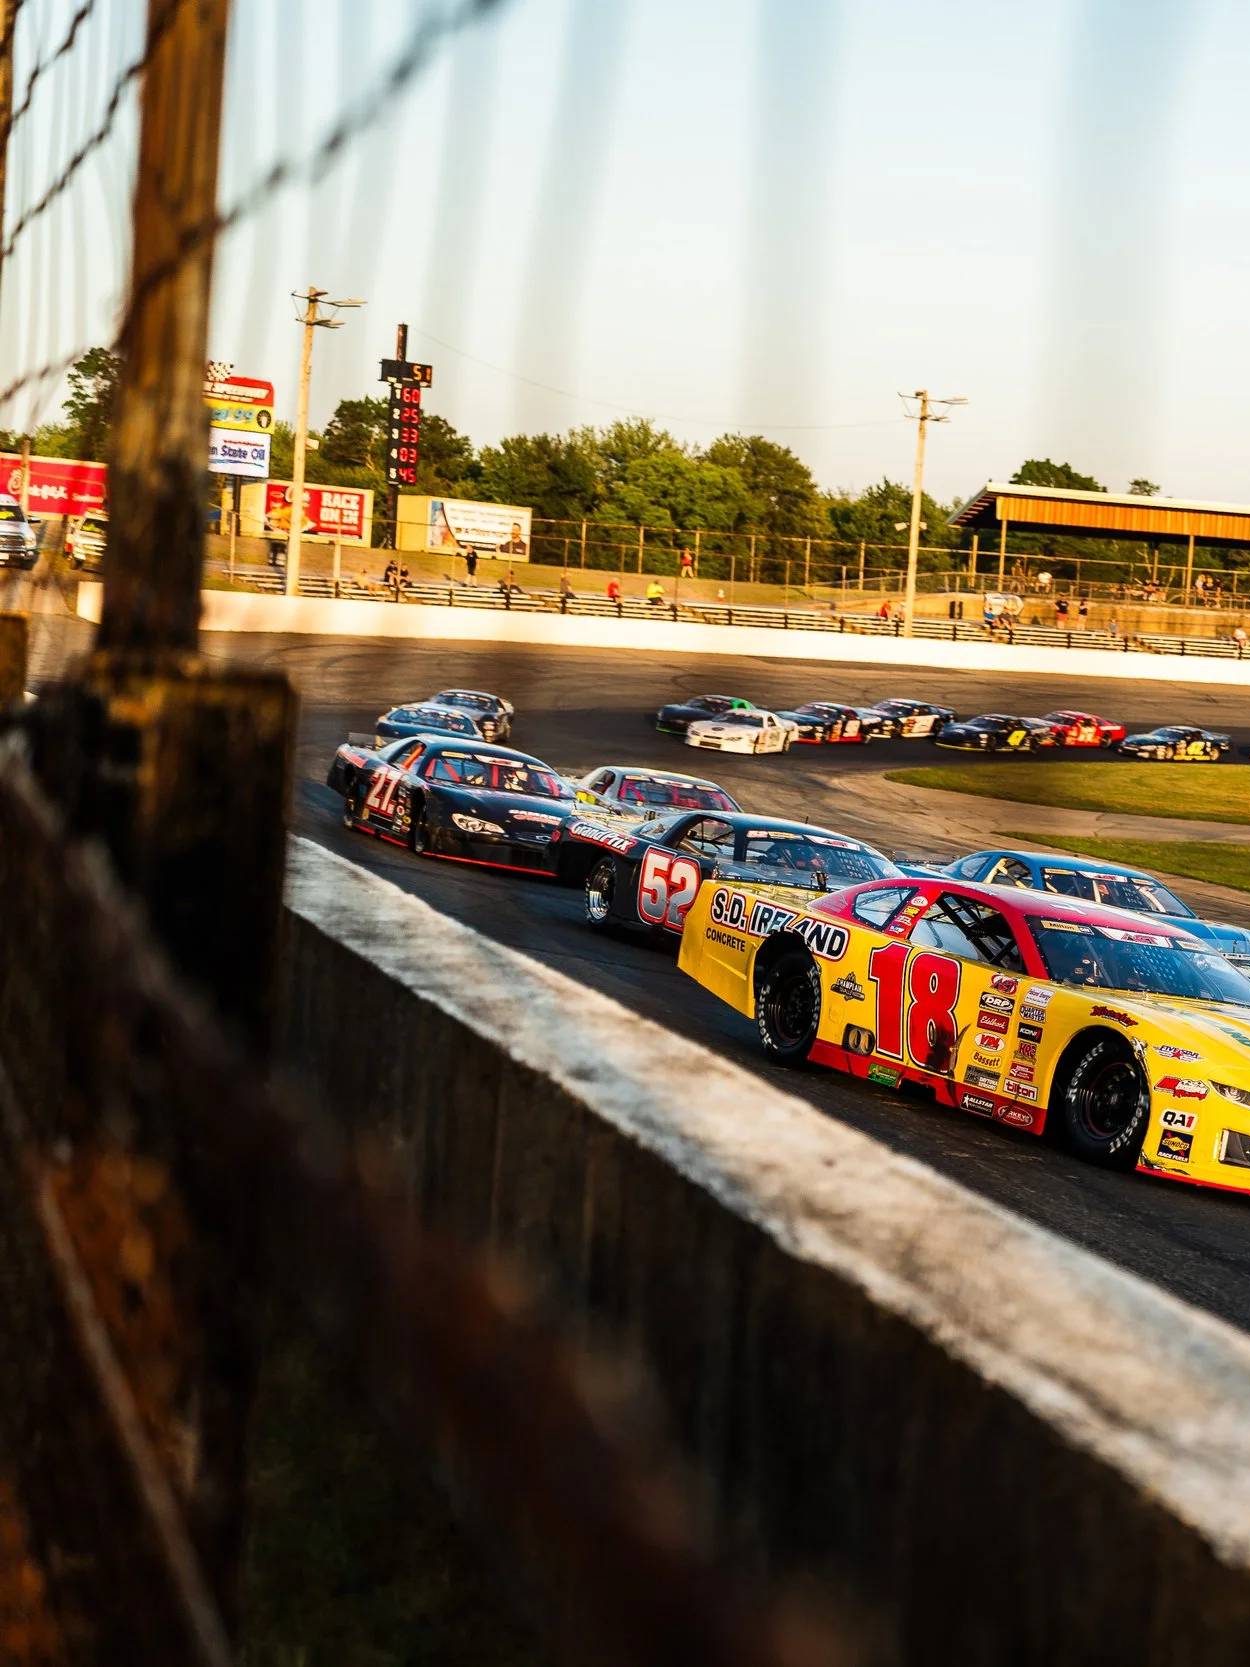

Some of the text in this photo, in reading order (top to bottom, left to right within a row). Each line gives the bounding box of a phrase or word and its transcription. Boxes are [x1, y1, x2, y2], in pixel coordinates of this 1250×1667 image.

[413, 365, 431, 381] 51
[402, 388, 421, 404] 60
[401, 407, 419, 424] 25
[401, 427, 418, 444] 33
[399, 447, 417, 464] 03
[398, 467, 416, 485] 45
[321, 492, 360, 511] RACE
[320, 507, 340, 523] ON
[638, 846, 700, 930] 52
[712, 891, 848, 958] S.D. IRELAND
[706, 927, 746, 953] CONCRETE
[868, 941, 962, 1075] 18
[985, 995, 1010, 1008] DRP
[980, 1016, 1006, 1029] Edelbrock
[1020, 1027, 1037, 1036] KONI
[974, 1052, 1000, 1067] Bassett
[1160, 1045, 1199, 1059] FIVE STAR
[1006, 1081, 1035, 1099] tilton
[969, 1097, 993, 1108] ALLSTAR
[1163, 1111, 1195, 1128] QA1
[1164, 1139, 1188, 1150] SUNOCO
